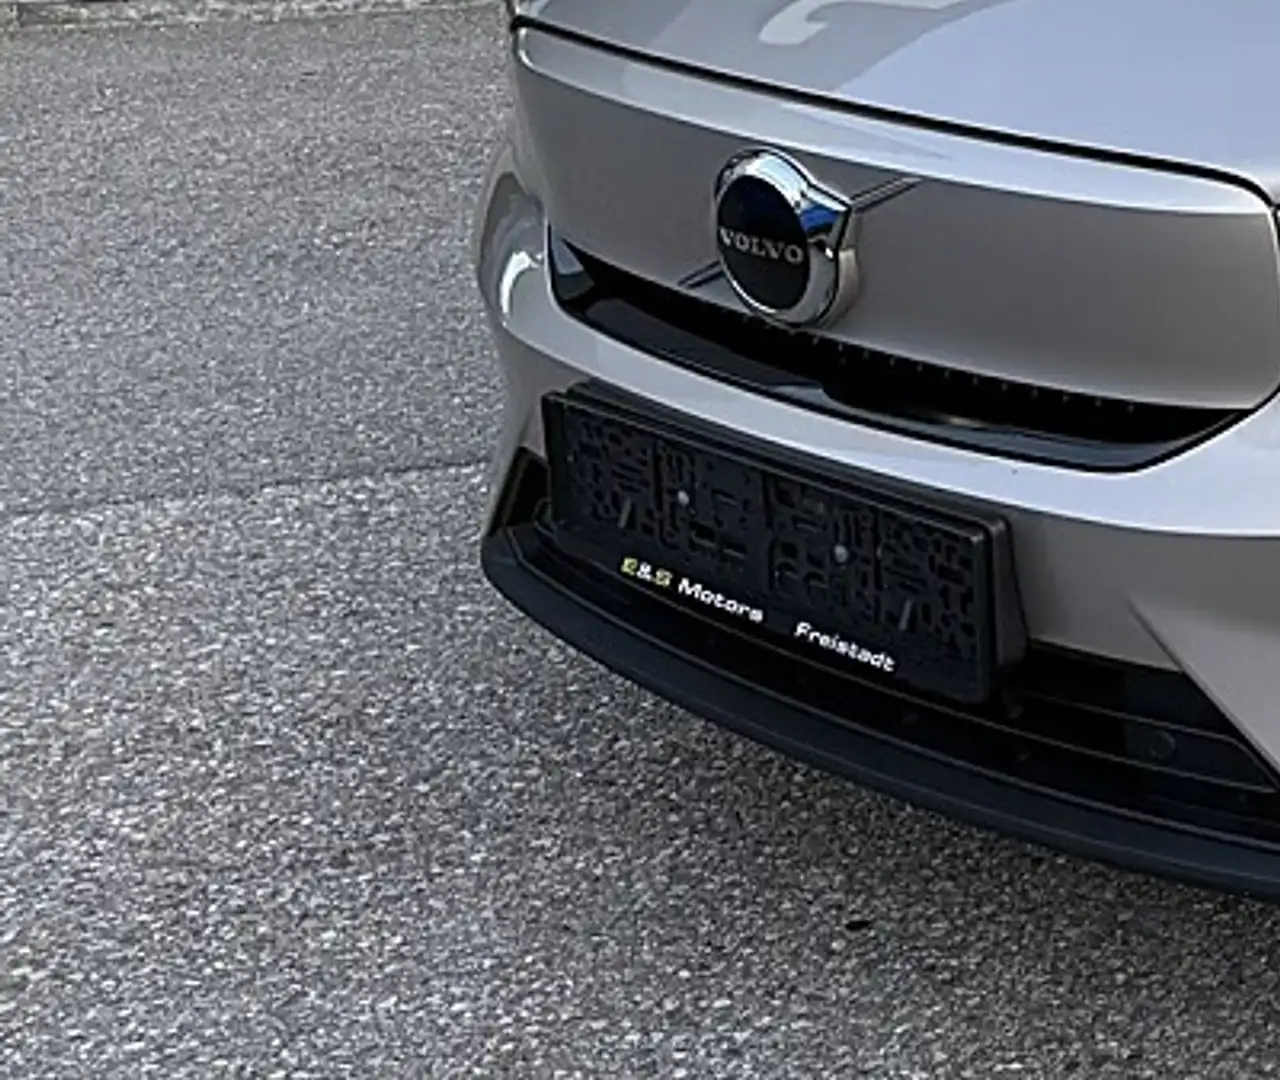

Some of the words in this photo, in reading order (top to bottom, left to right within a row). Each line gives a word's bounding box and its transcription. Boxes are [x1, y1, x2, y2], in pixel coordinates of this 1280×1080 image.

[720, 225, 804, 264] VOLVO
[620, 556, 674, 588] E&S
[677, 576, 764, 623] Motors
[793, 620, 896, 672] Freistadt
